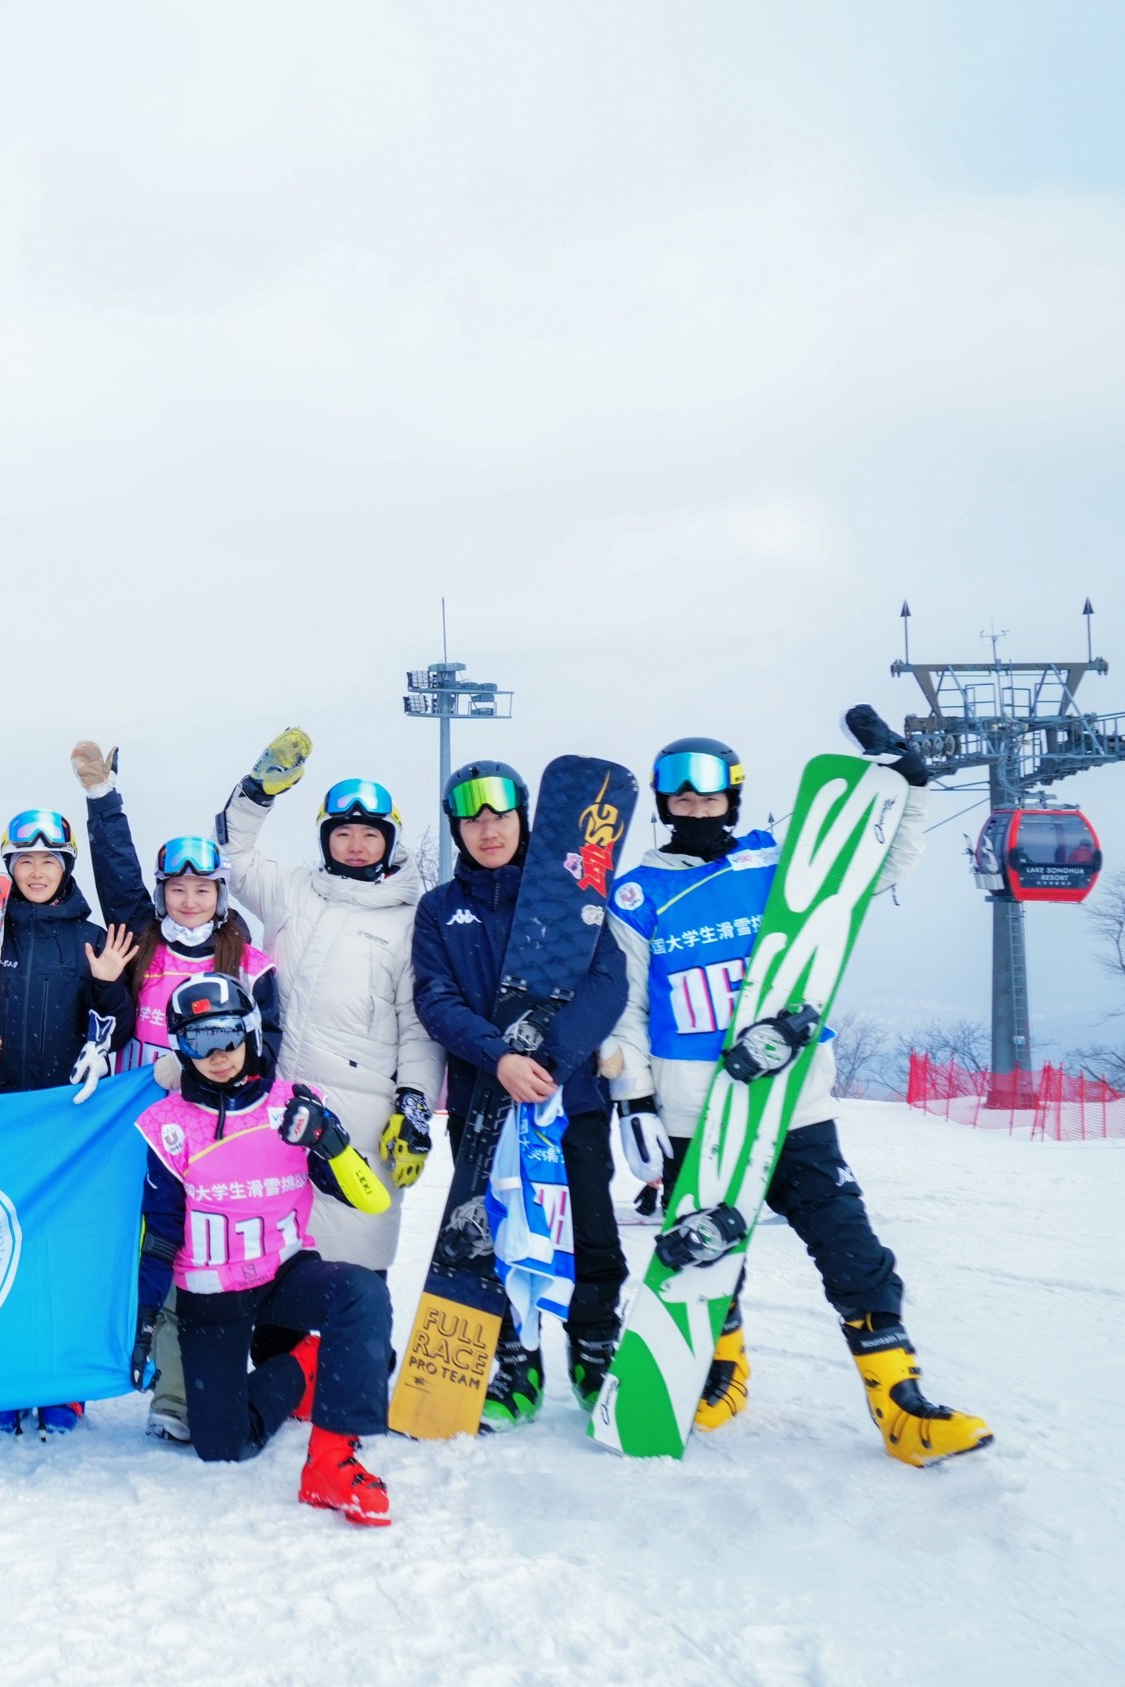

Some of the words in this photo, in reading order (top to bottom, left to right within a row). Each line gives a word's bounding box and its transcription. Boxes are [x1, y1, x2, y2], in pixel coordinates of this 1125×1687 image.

[355, 1170, 372, 1195] LEKI
[423, 1307, 486, 1349] FULL
[413, 1330, 488, 1376] RACE
[409, 1356, 437, 1375] PRO
[441, 1366, 481, 1390] TEAM
